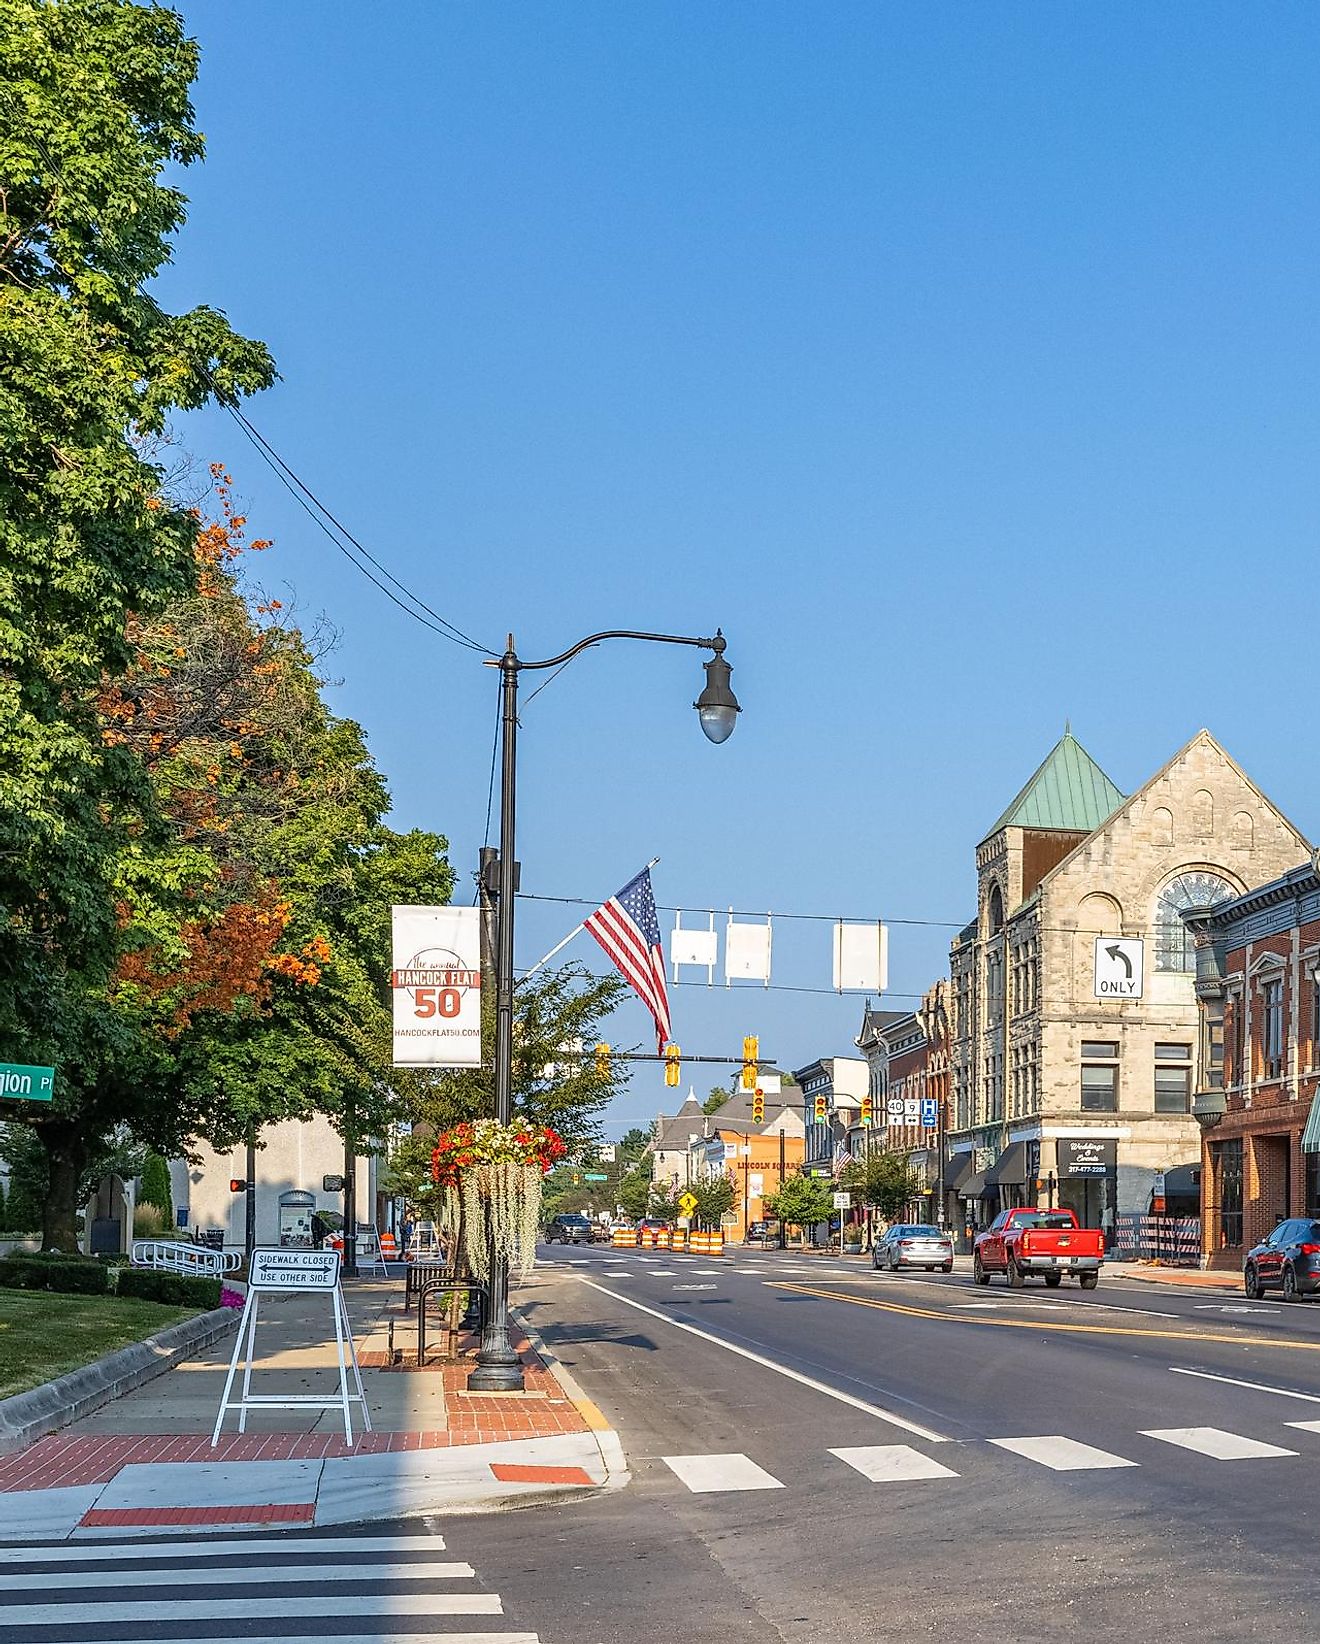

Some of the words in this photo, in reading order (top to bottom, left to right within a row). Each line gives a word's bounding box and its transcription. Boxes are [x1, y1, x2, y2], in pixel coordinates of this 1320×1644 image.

[398, 970, 448, 986] HANCOCK
[451, 970, 476, 986] FLAT
[1100, 981, 1136, 993] ONLY
[414, 988, 461, 1018] 50
[395, 1028, 480, 1037] HANCOCKFLAT50.COM
[889, 1102, 902, 1111] 40
[909, 1104, 916, 1112] 9
[923, 1101, 936, 1114] H
[1070, 1142, 1105, 1152] Weddings
[258, 1254, 299, 1265] SIDEWALK
[302, 1256, 334, 1265] CLOSED
[260, 1273, 276, 1281] USE
[279, 1273, 307, 1282] OTHER
[309, 1274, 329, 1283] SIDE
